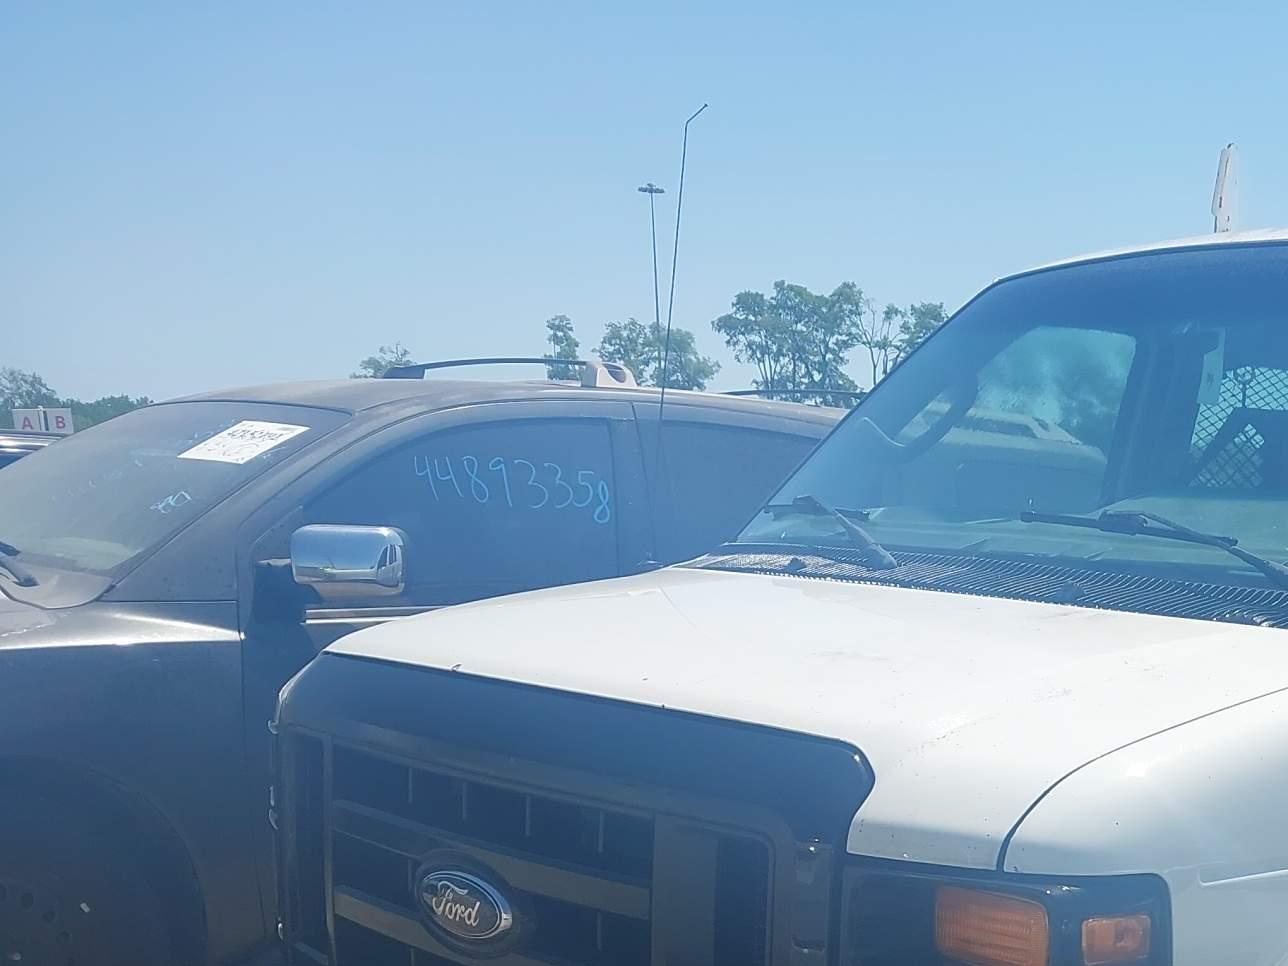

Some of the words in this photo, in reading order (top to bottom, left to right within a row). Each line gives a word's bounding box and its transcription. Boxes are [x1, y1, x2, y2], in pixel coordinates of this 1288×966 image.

[22, 416, 33, 430] A
[55, 416, 66, 429] B
[414, 455, 611, 524] 44893358
[432, 880, 481, 927] Ford
